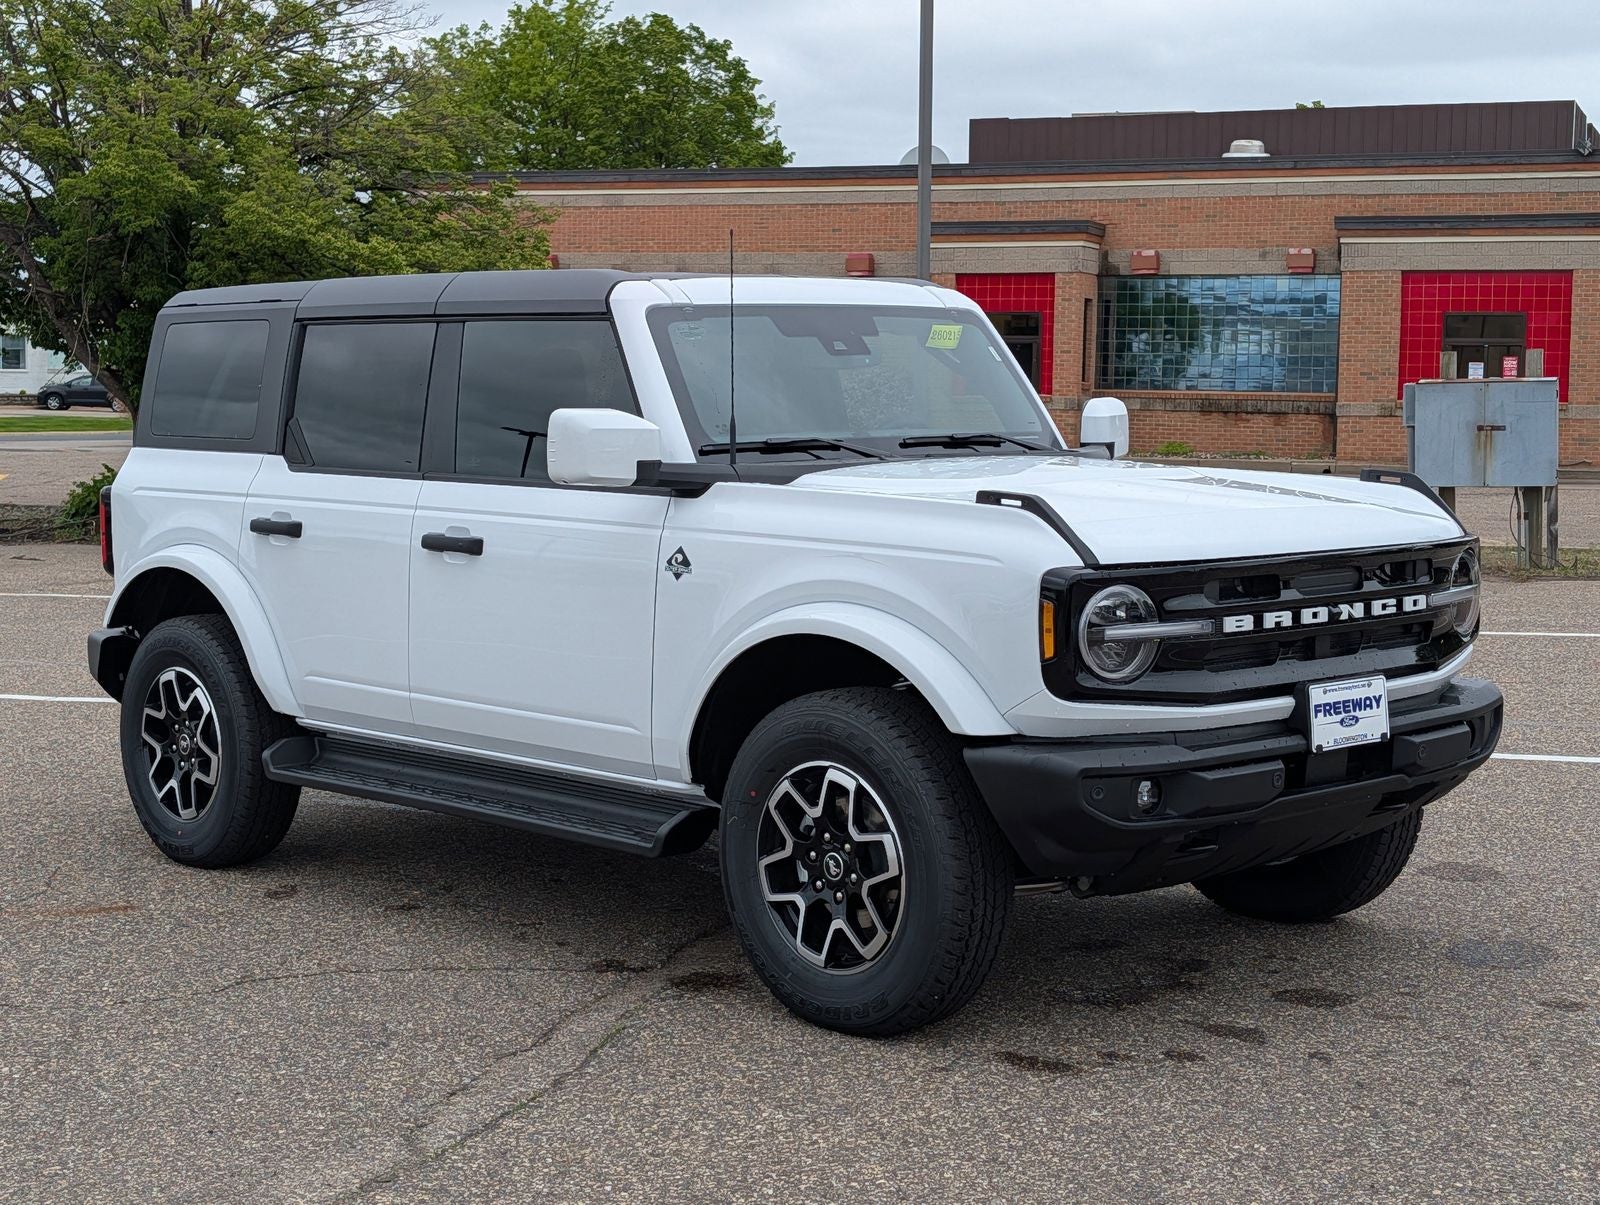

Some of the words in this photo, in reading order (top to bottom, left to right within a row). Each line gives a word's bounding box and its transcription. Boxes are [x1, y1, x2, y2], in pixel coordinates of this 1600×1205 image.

[1222, 594, 1427, 633] BRONCO
[1313, 694, 1383, 719] FREEWAY
[1341, 716, 1357, 727] Ford
[1333, 732, 1368, 745] BLOOMINGTON
